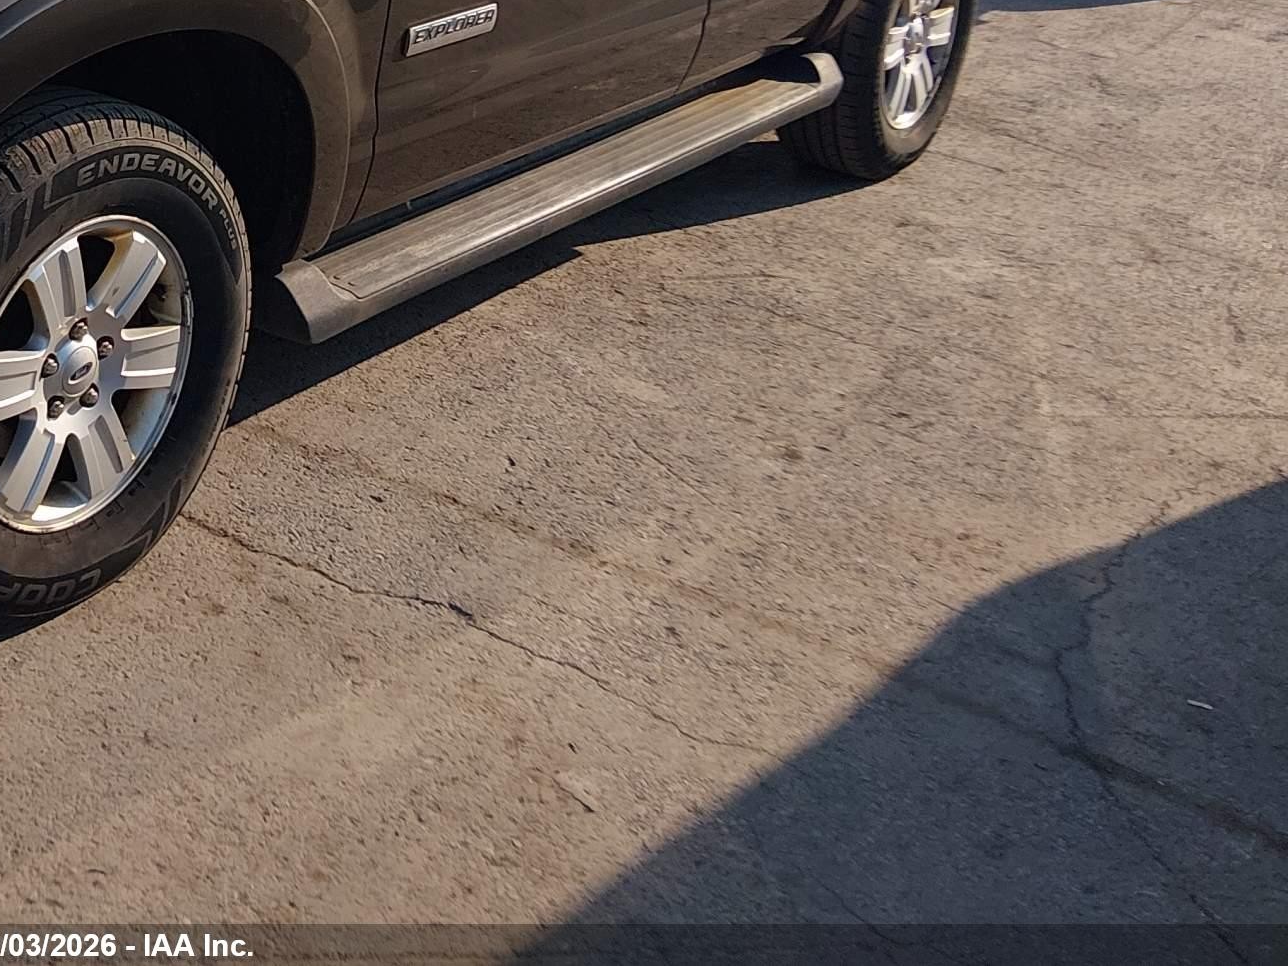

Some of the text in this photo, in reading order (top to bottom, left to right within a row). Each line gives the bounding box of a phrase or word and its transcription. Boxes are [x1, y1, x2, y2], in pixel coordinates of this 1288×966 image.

[413, 9, 495, 45] EXPLORER
[77, 152, 238, 251] ENDEAVOR PLUS
